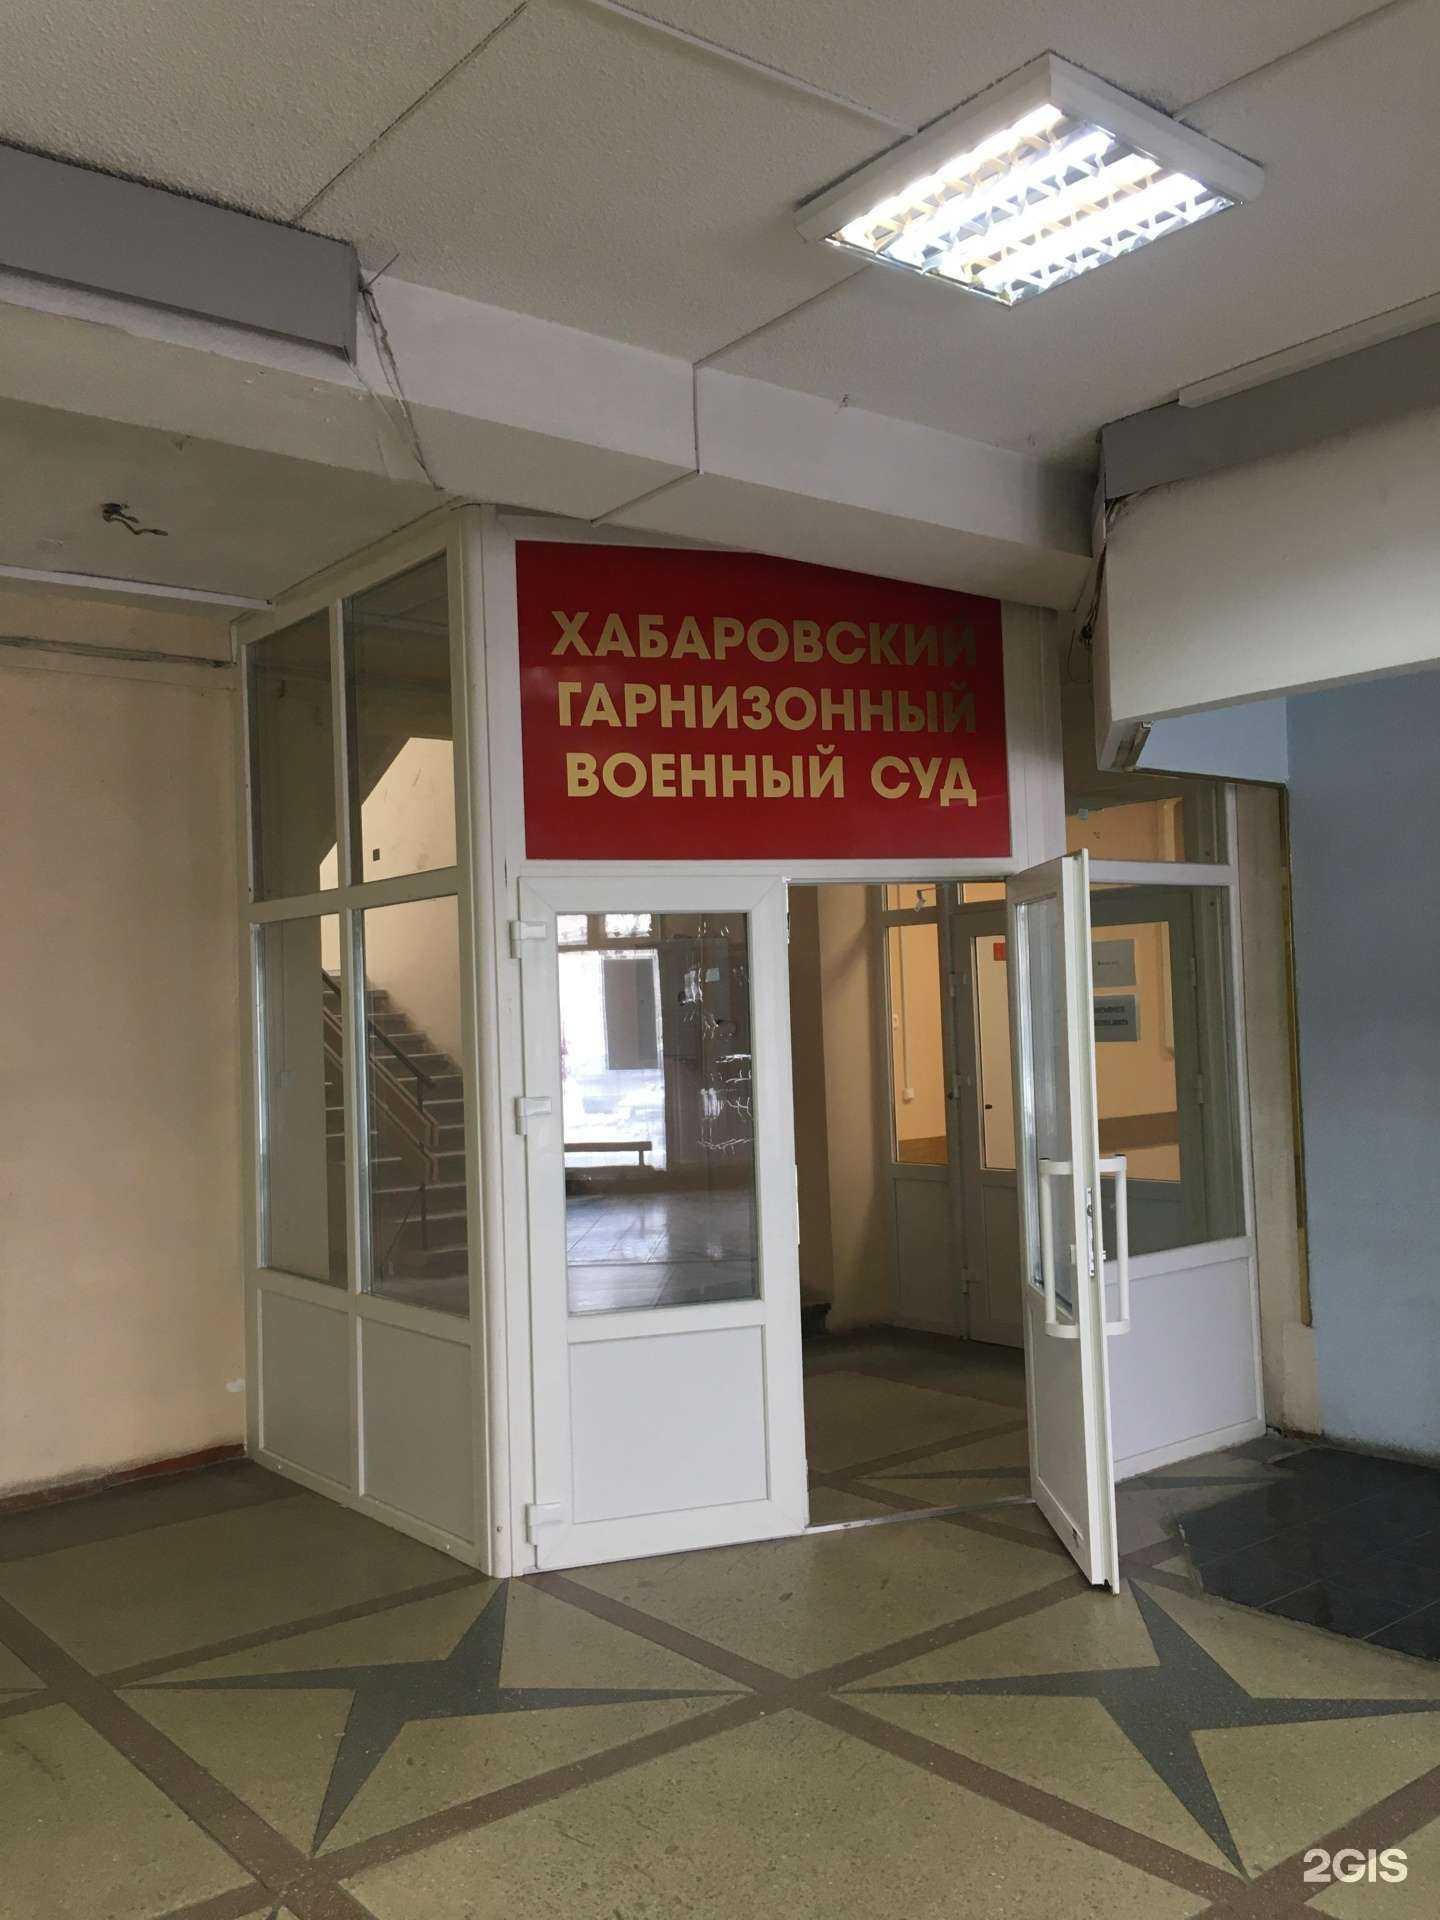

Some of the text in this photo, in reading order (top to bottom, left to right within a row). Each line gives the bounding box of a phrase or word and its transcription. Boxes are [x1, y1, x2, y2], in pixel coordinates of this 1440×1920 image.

[557, 680, 977, 733] ГАРНИЗОННЫЙ
[566, 744, 977, 806] ВОЕННЫЙ СУД
